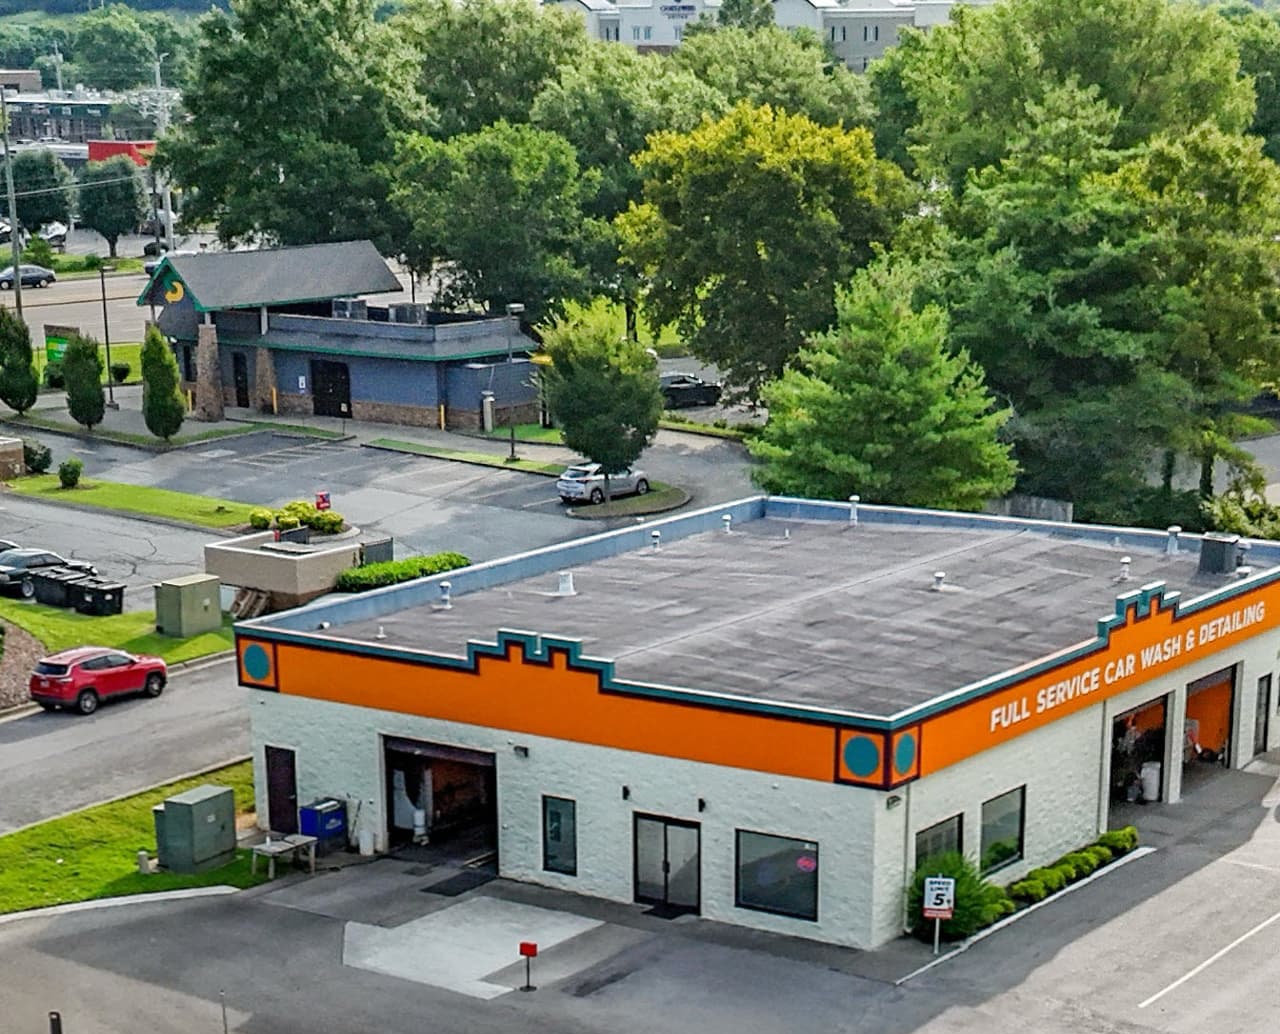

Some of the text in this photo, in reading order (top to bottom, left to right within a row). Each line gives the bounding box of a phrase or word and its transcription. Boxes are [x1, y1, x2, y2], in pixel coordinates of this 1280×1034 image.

[989, 601, 1266, 732] FULL SERVICE CAR WASH & DETAILING
[932, 892, 945, 906] 5
